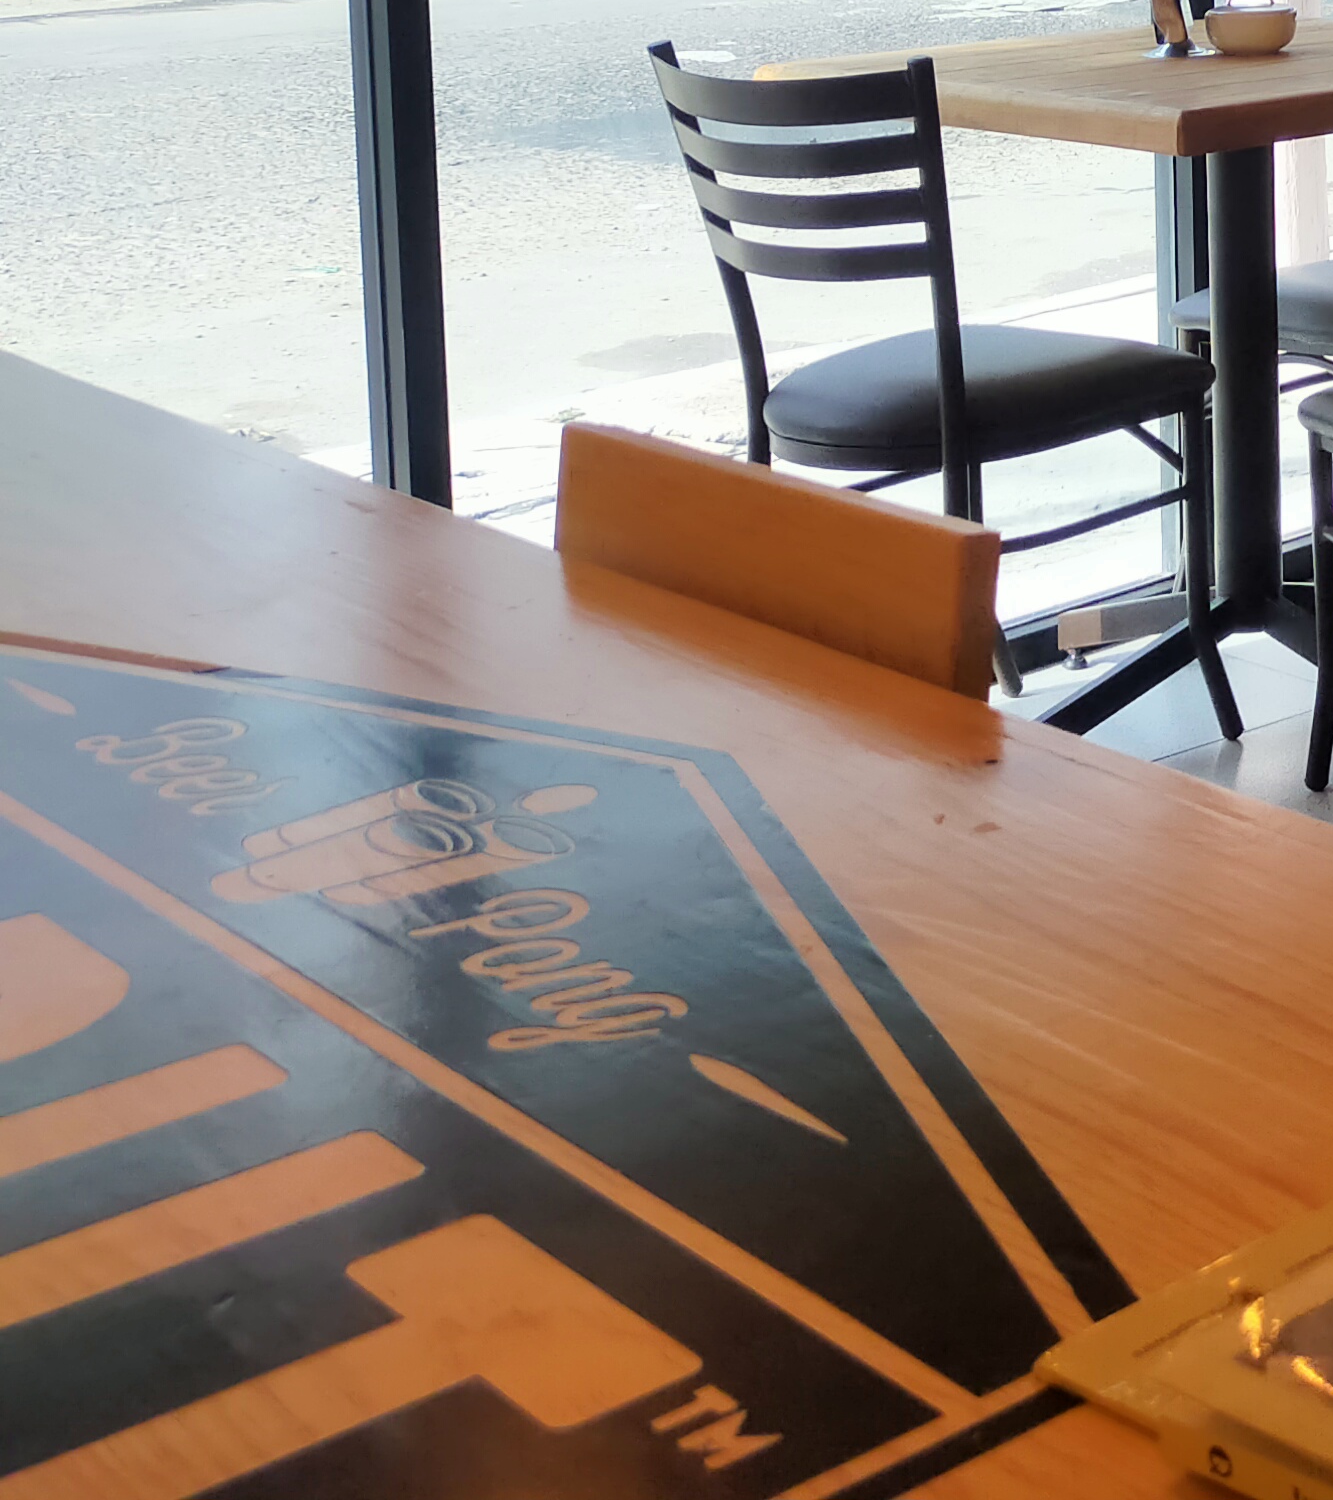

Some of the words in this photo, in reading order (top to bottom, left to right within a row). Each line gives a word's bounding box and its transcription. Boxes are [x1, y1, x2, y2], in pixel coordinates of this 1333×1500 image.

[75, 716, 298, 815] Beer
[408, 888, 690, 1052] Pong
[651, 1384, 784, 1472] TM
